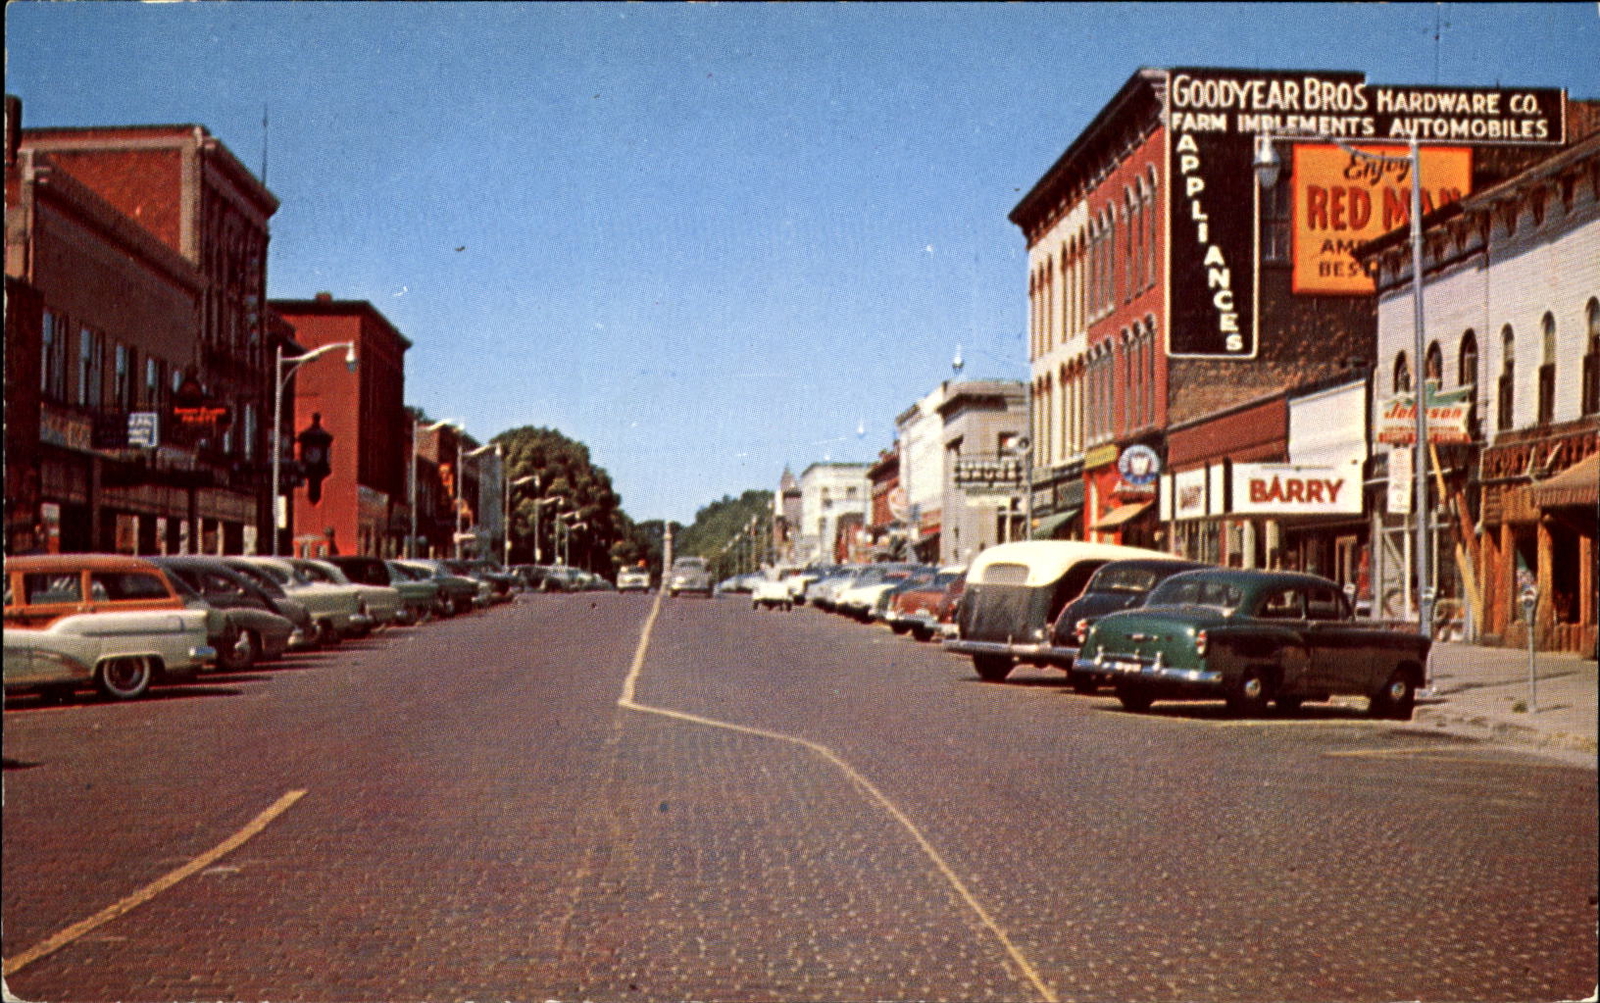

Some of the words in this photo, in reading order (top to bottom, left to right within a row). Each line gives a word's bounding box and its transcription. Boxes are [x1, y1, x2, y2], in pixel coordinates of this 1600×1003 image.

[1173, 74, 1300, 110] GOODYEAR
[1304, 77, 1369, 111] BROS
[1377, 89, 1501, 114] HARDWARE
[1510, 94, 1543, 115] CO.
[1172, 112, 1227, 131] FARM
[1237, 114, 1375, 135] IMPLEMENTS
[1389, 118, 1548, 138] AUTOMOBILES
[1307, 185, 1371, 231] RED
[1176, 134, 1243, 351] APPLIANCES
[1249, 477, 1344, 503] BARRY
